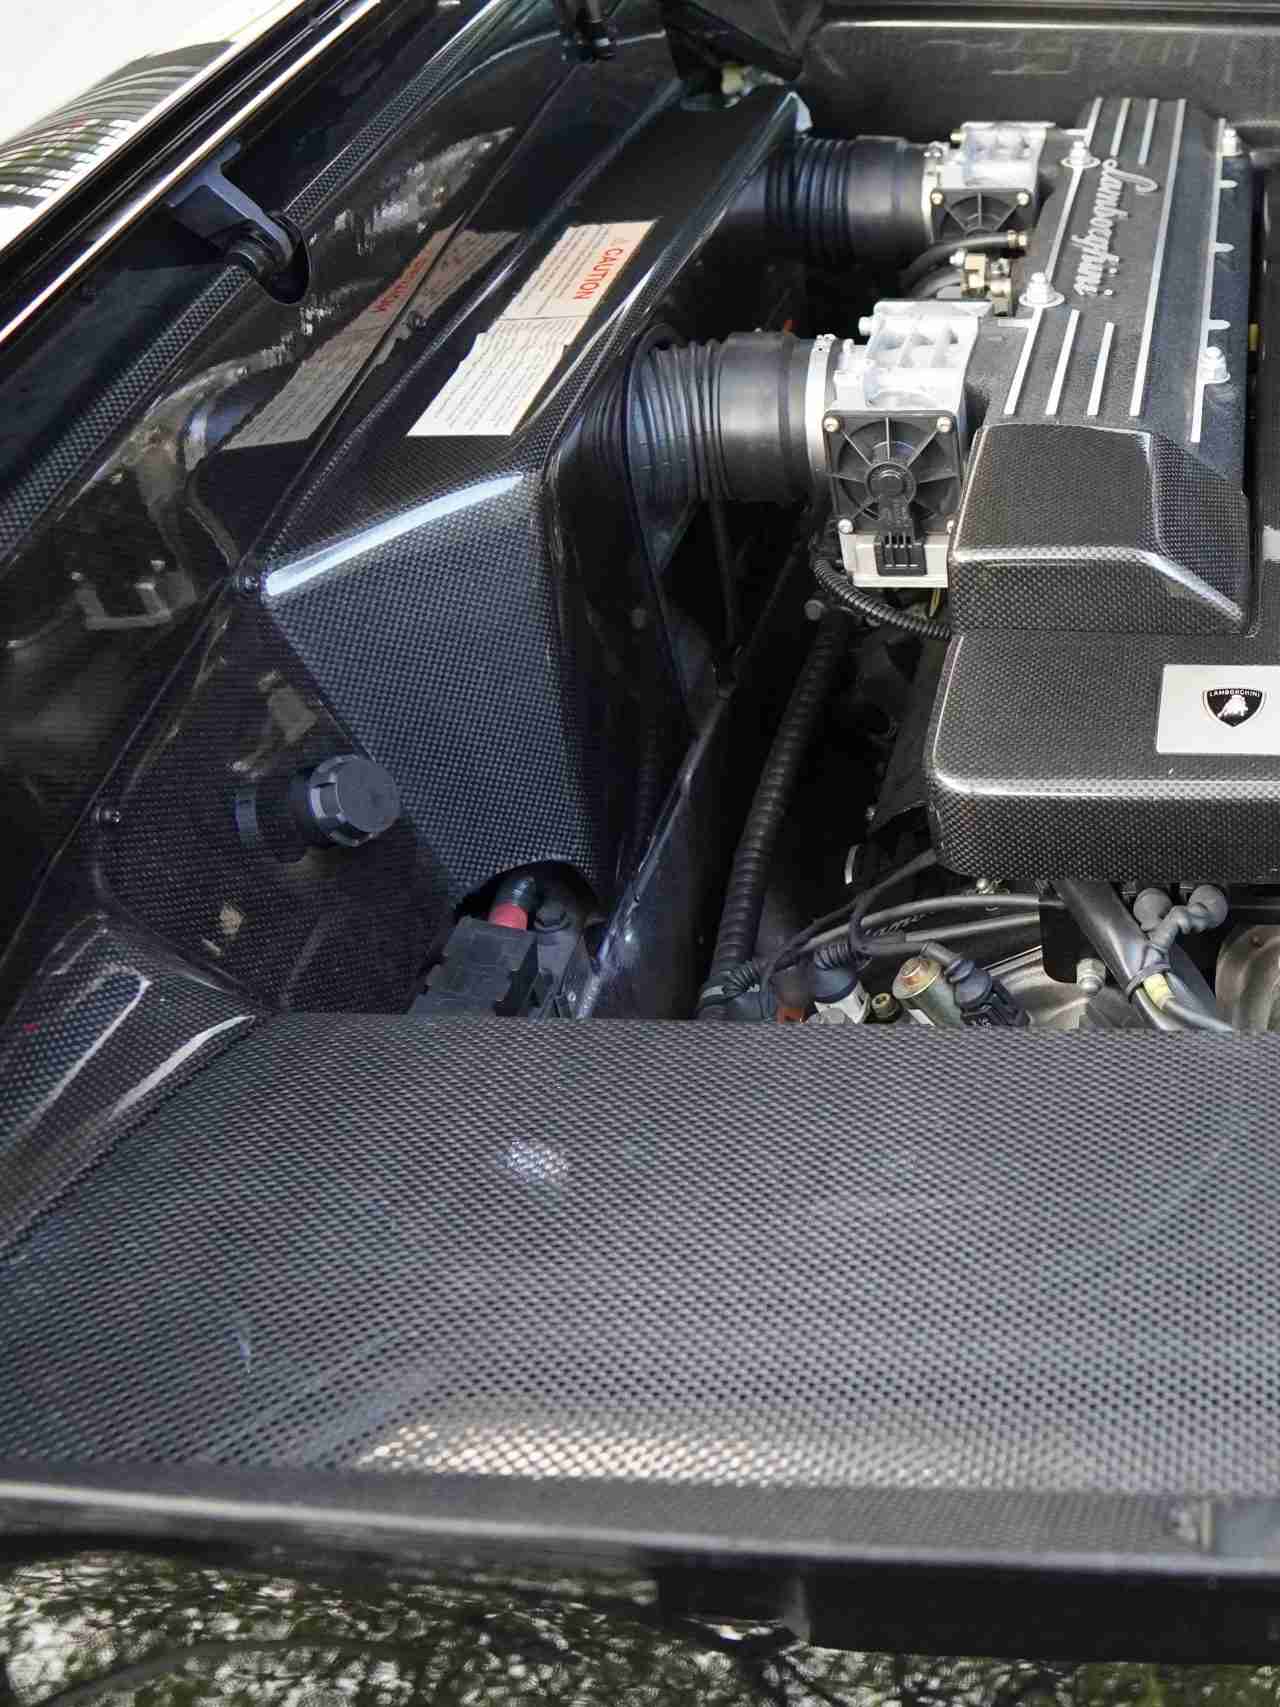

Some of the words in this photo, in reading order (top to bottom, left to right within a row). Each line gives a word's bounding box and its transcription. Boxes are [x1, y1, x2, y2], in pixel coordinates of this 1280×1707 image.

[1071, 159, 1158, 295] Lamborghini
[573, 248, 624, 299] CAUTION
[1209, 689, 1260, 698] LAMBORGHINI
